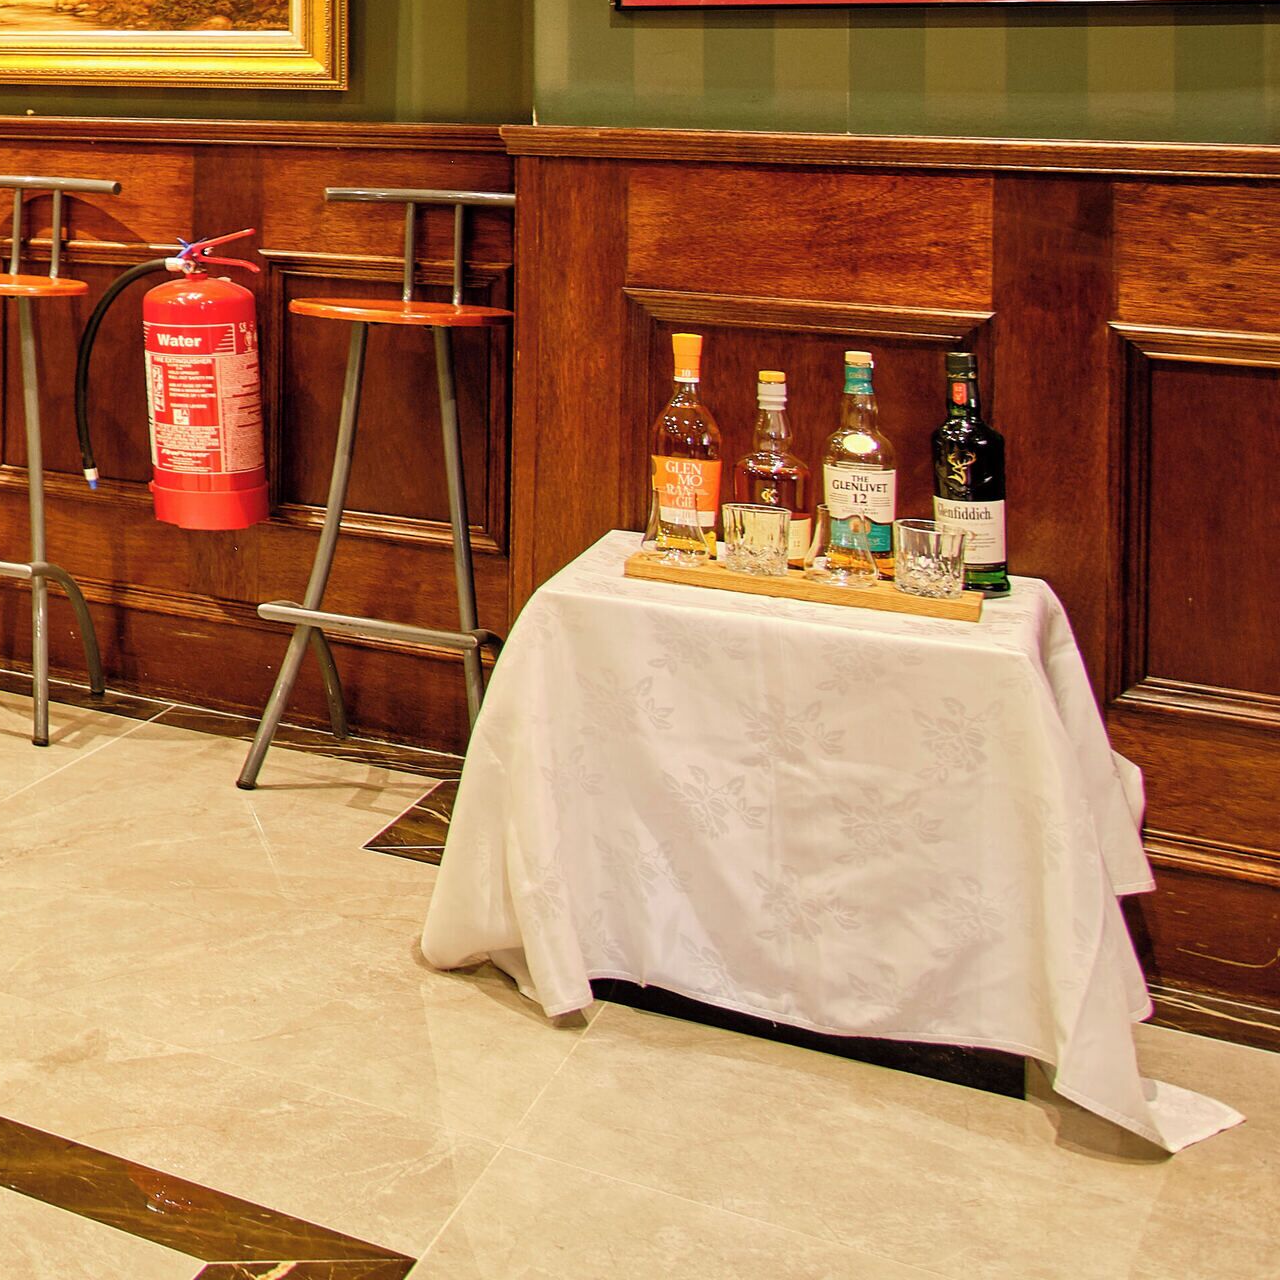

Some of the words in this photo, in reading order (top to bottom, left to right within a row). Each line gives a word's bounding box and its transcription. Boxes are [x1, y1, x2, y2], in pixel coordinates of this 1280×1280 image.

[156, 332, 202, 348] Water
[665, 460, 702, 475] GLEN
[677, 474, 703, 486] MO
[832, 479, 888, 493] GLENLIVET
[852, 475, 870, 483] THE
[852, 493, 868, 504] 12
[937, 503, 993, 521] Glenfiddich
